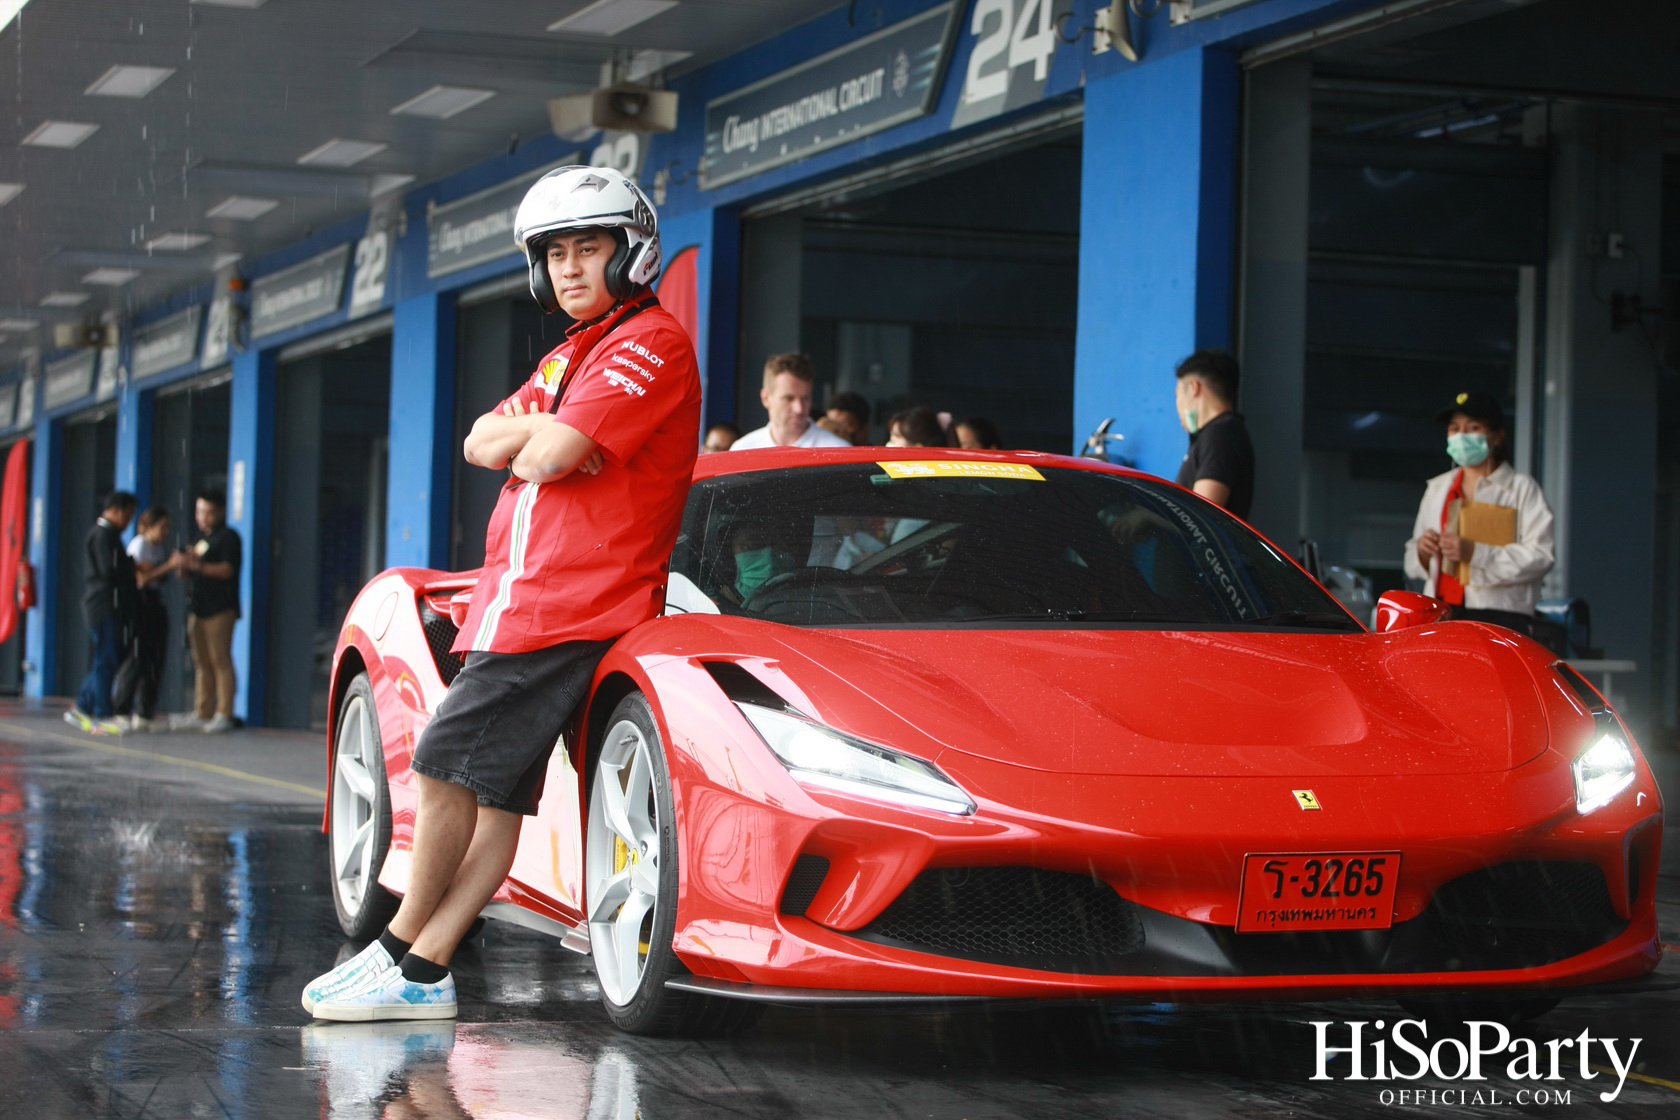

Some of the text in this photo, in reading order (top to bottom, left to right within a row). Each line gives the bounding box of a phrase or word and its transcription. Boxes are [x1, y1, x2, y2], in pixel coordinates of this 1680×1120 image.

[965, 0, 1056, 104] 24
[722, 68, 886, 154] Chang INTERNATIONAL CIRCUIT
[351, 231, 389, 307] 22
[611, 353, 656, 383] kaspersky
[621, 340, 665, 368] HUBLOT
[602, 367, 647, 397] WEICHAI
[937, 463, 1034, 474] SINGHA
[1256, 906, 1377, 927] กรุงเทพมหานคร
